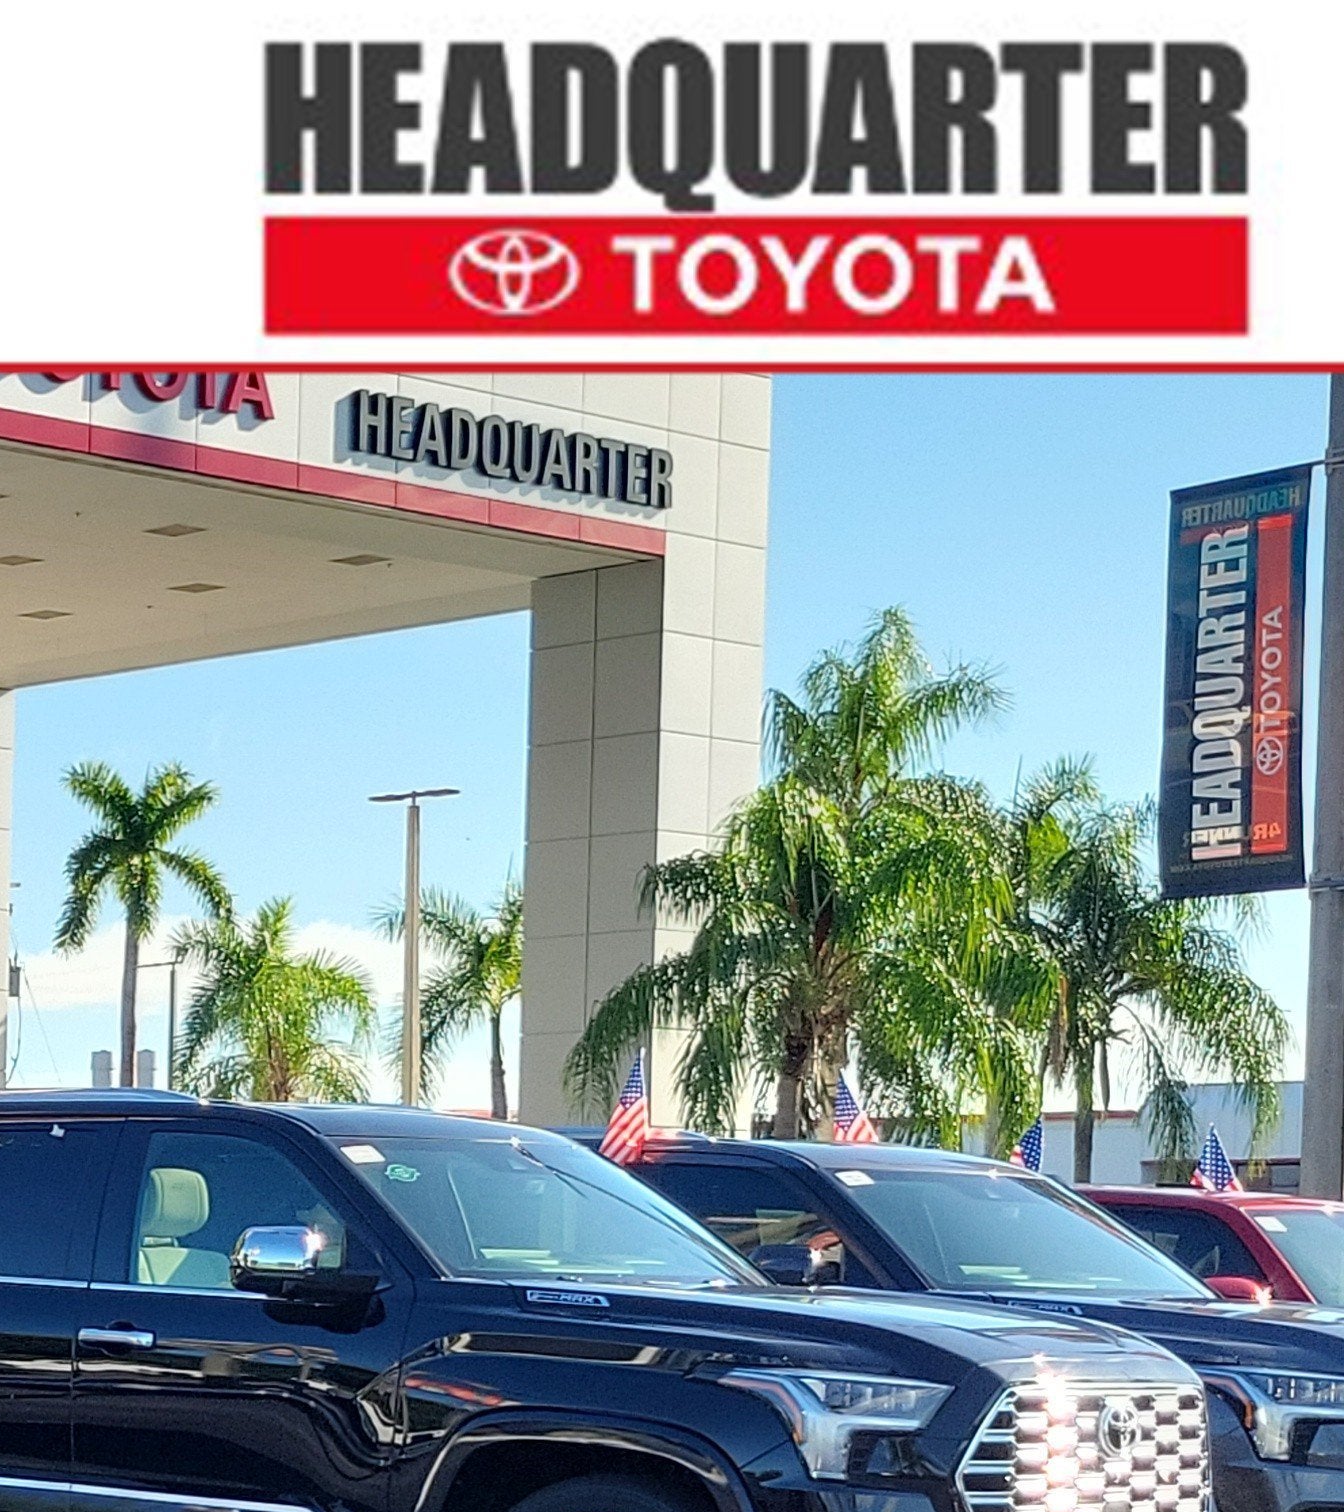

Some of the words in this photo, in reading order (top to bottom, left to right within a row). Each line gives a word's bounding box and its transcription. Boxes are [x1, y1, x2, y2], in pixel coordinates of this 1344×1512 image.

[356, 390, 673, 509] HEADQUARTER
[1191, 522, 1249, 861] HEADQUARTER
[1258, 605, 1284, 734] TOYOTA
